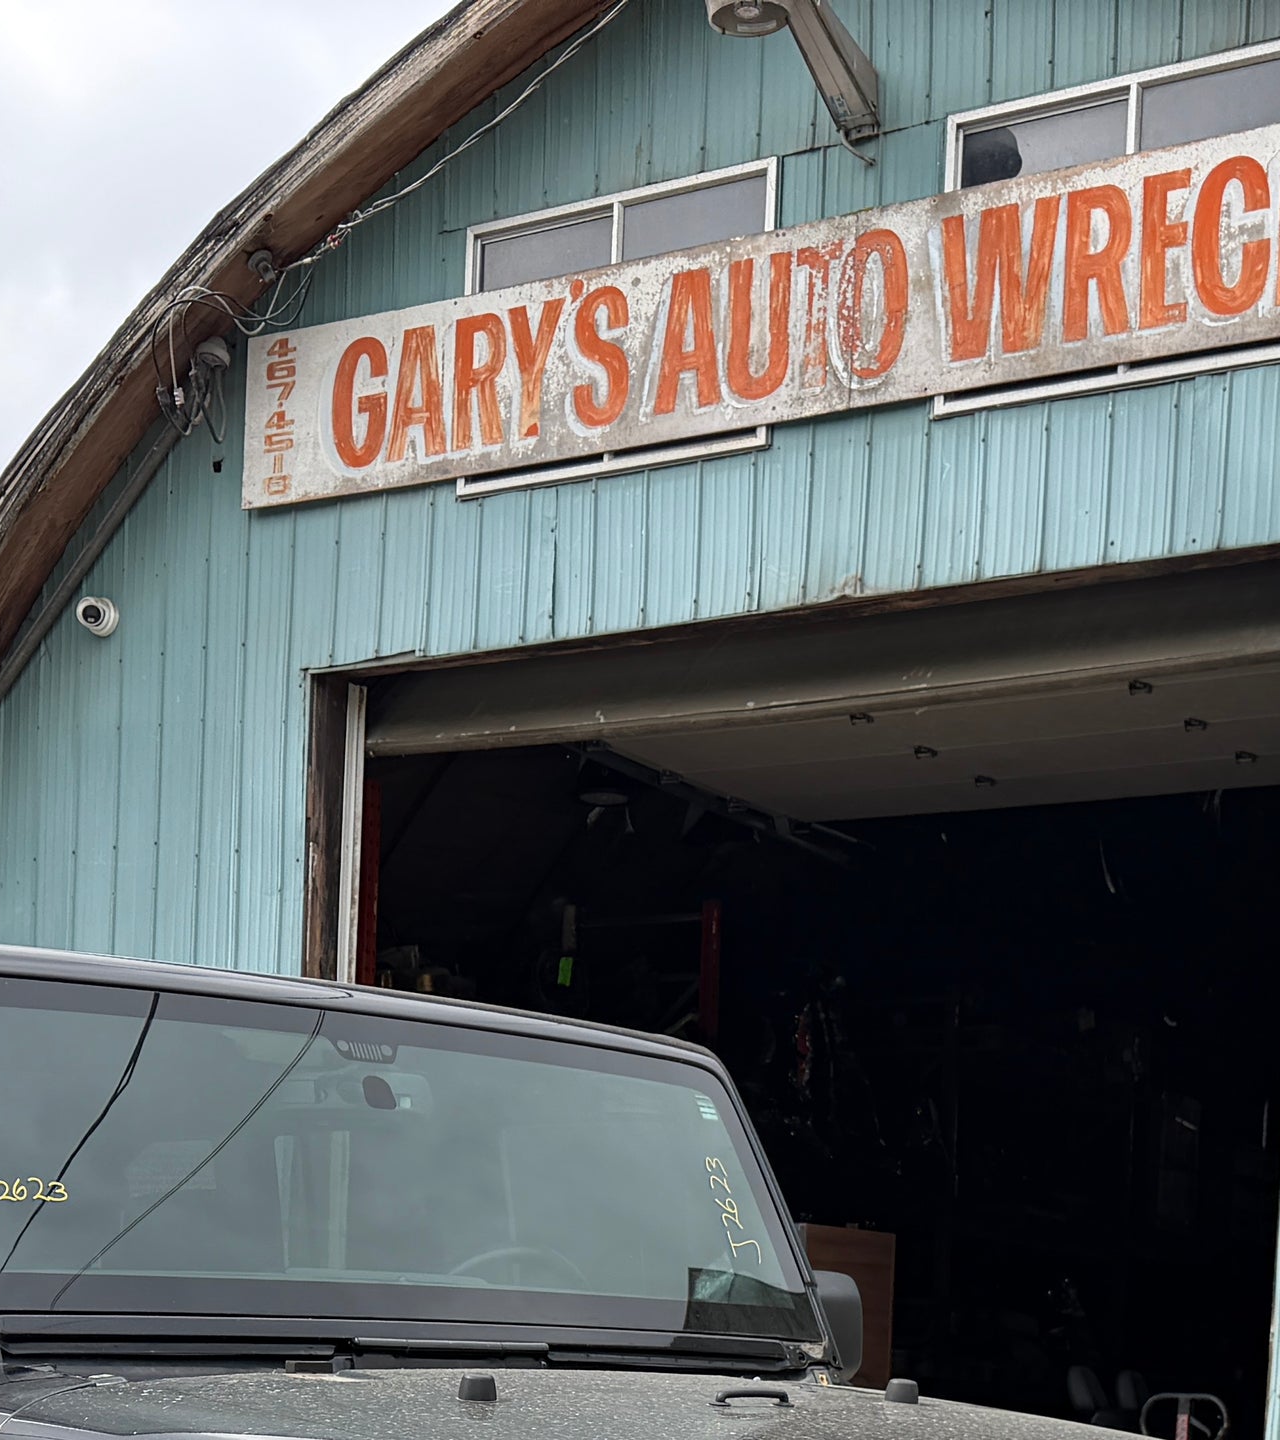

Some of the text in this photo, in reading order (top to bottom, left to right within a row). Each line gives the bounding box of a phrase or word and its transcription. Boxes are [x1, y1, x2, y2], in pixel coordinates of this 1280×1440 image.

[332, 278, 629, 469] GARY'S
[652, 228, 910, 415] AUTO
[704, 1156, 762, 1264] J2623
